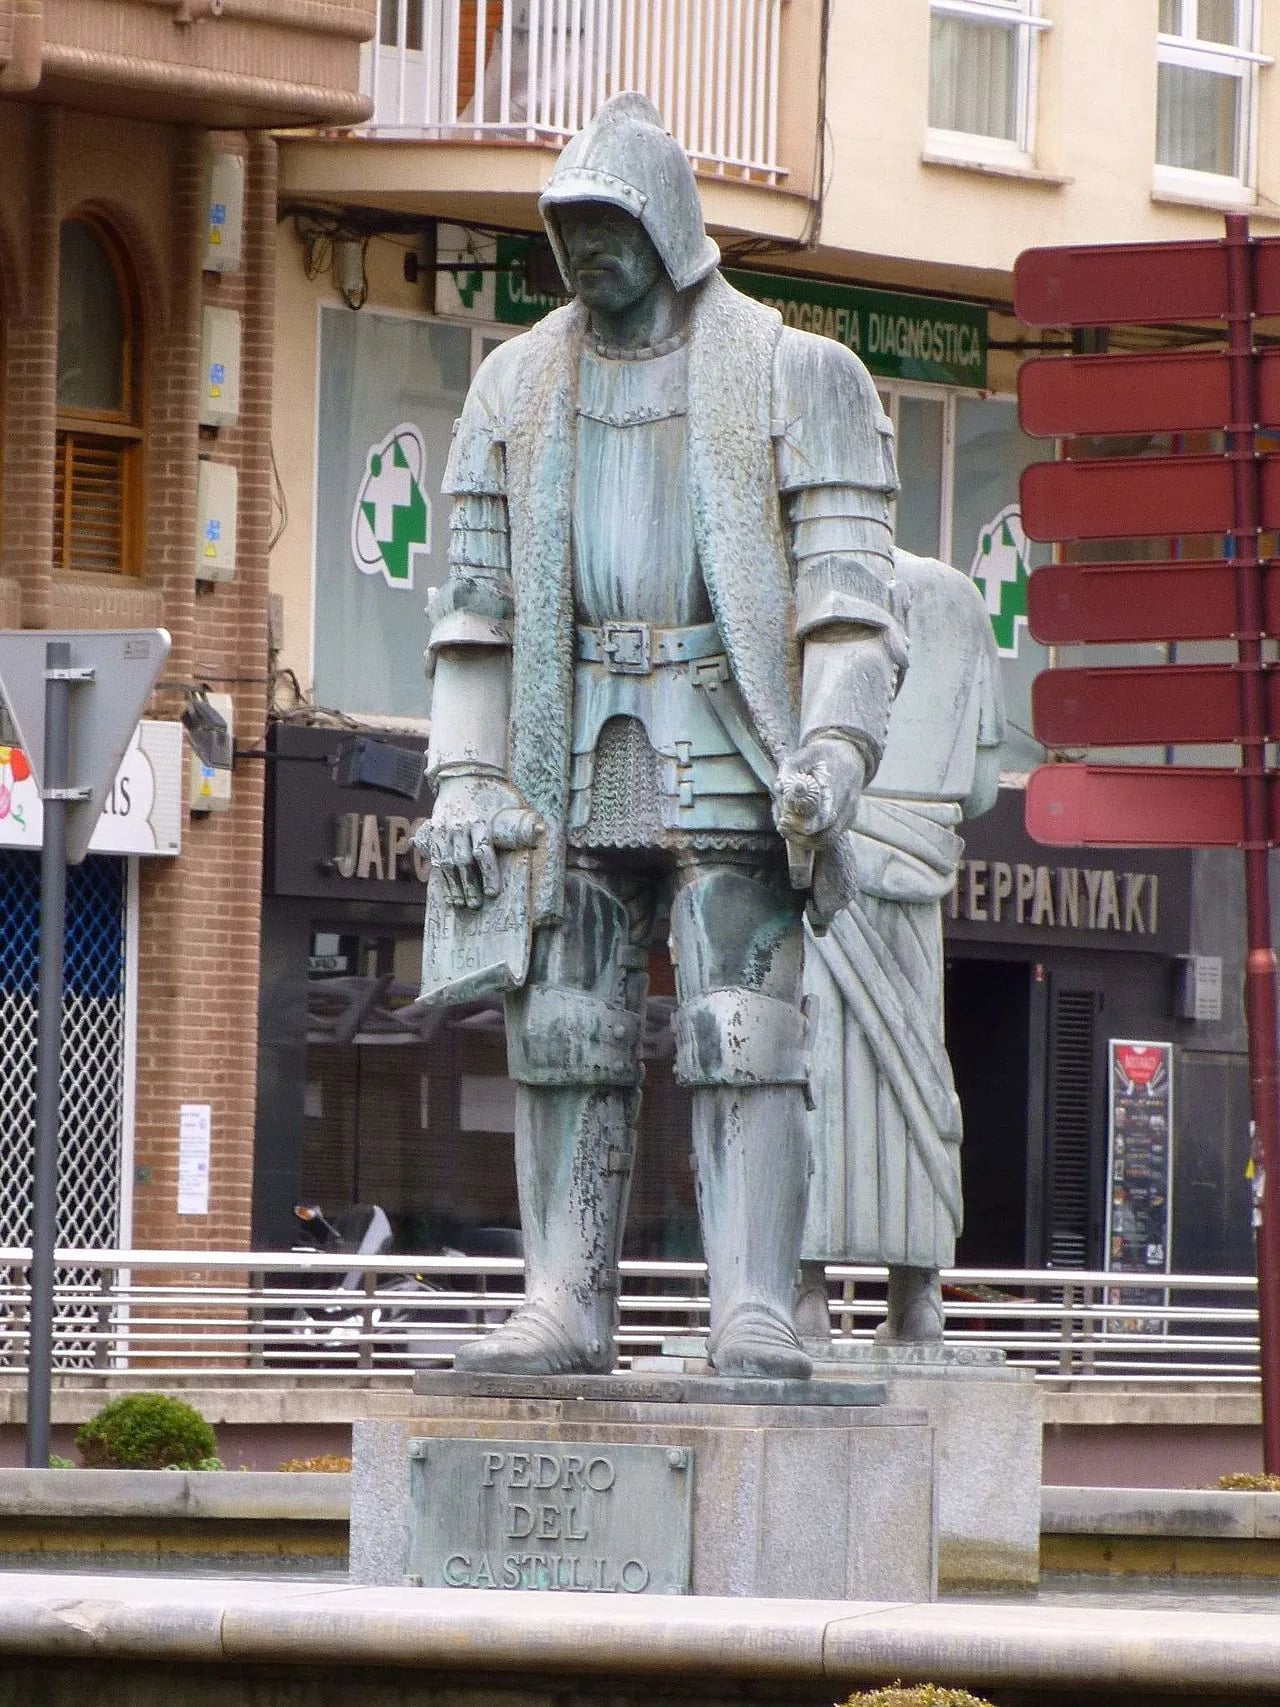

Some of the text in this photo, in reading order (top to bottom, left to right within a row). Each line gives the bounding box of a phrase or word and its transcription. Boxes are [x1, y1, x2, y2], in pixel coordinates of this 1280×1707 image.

[761, 298, 982, 366] OGRAFIA DIAGNOSTICA
[335, 813, 432, 881] JAPO
[951, 860, 1158, 934] TEPPANYAKI
[482, 1451, 617, 1492] PEDRO
[506, 1503, 589, 1540] DEL
[442, 1554, 651, 1594] CASTILLO
